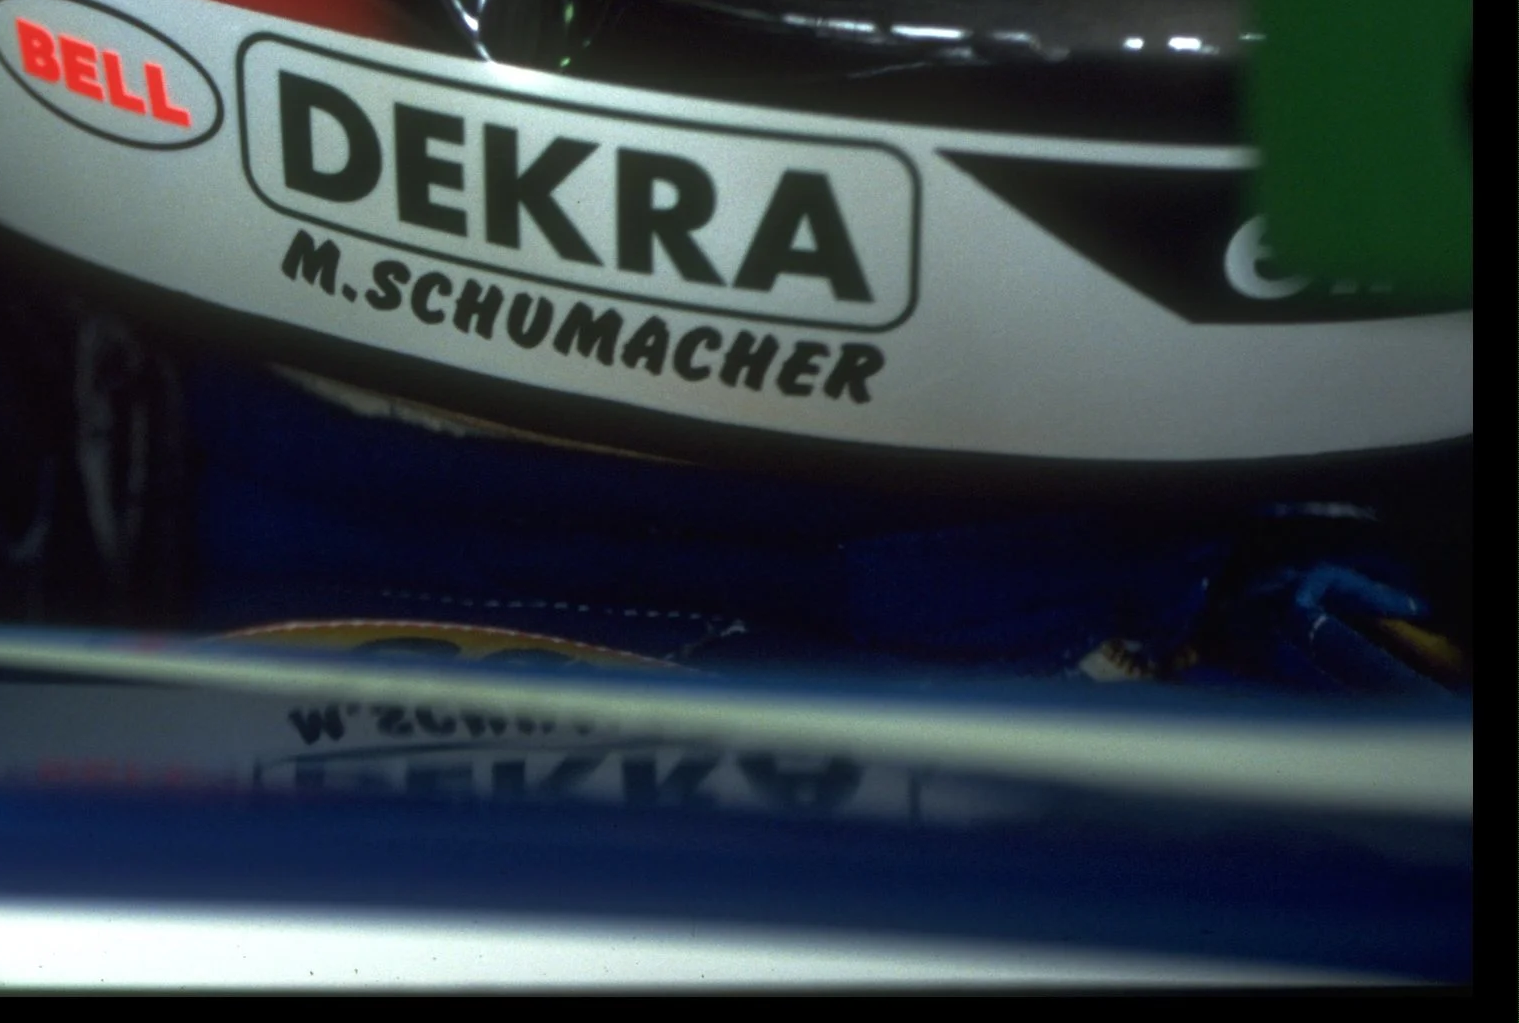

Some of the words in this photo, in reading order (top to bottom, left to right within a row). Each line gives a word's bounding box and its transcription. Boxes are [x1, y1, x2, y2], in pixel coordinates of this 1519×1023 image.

[14, 16, 191, 129] BELL
[277, 68, 876, 305] DEKRA
[281, 228, 887, 405] M.SCHUMACHER
